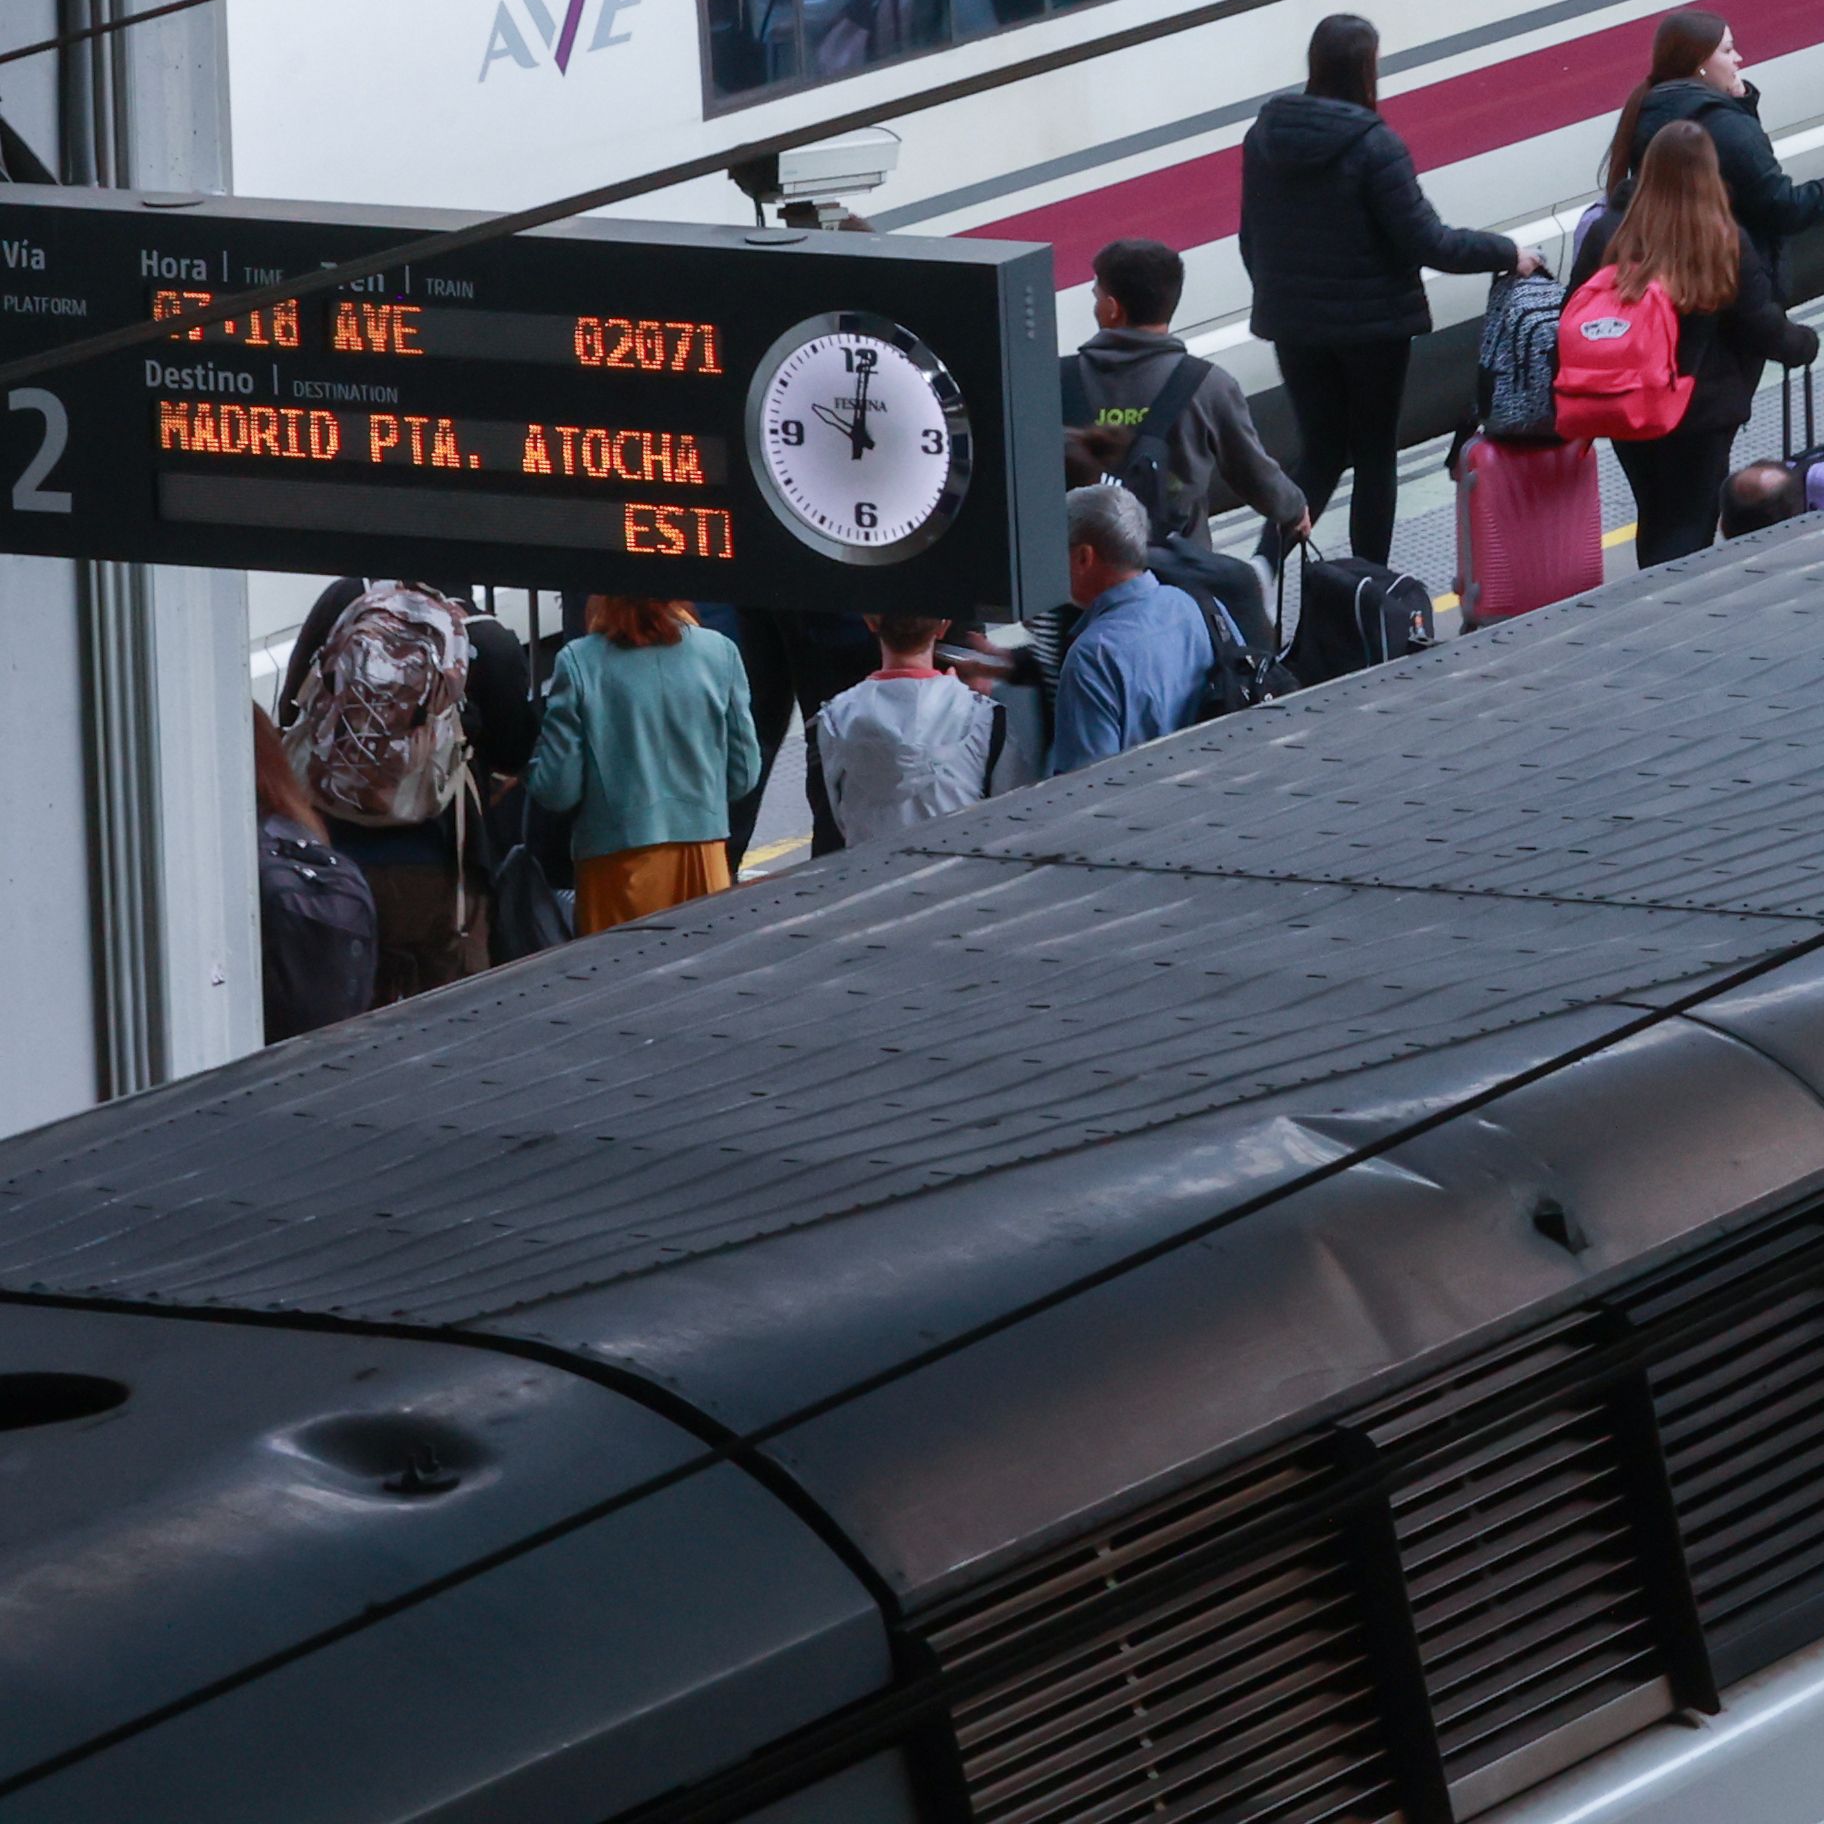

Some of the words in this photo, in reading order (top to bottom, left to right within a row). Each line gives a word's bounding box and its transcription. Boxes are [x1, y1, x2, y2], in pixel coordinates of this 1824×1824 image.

[2, 239, 46, 270] Vía
[140, 249, 208, 282] Hora
[425, 278, 474, 300] TRAIN
[3, 294, 87, 318] PLATFORM
[334, 302, 425, 356] AVE
[574, 316, 723, 375] 02071
[840, 347, 879, 375] 12
[144, 359, 255, 395] Destino
[293, 379, 400, 405] DESTINATION
[834, 397, 888, 413] FESINA
[160, 400, 341, 461] MADRID
[369, 414, 481, 470] PTA.
[521, 424, 704, 485] ATOCHA
[781, 420, 804, 447] 9
[921, 429, 944, 455] 3
[8, 387, 72, 514] 2
[854, 502, 879, 528] 6
